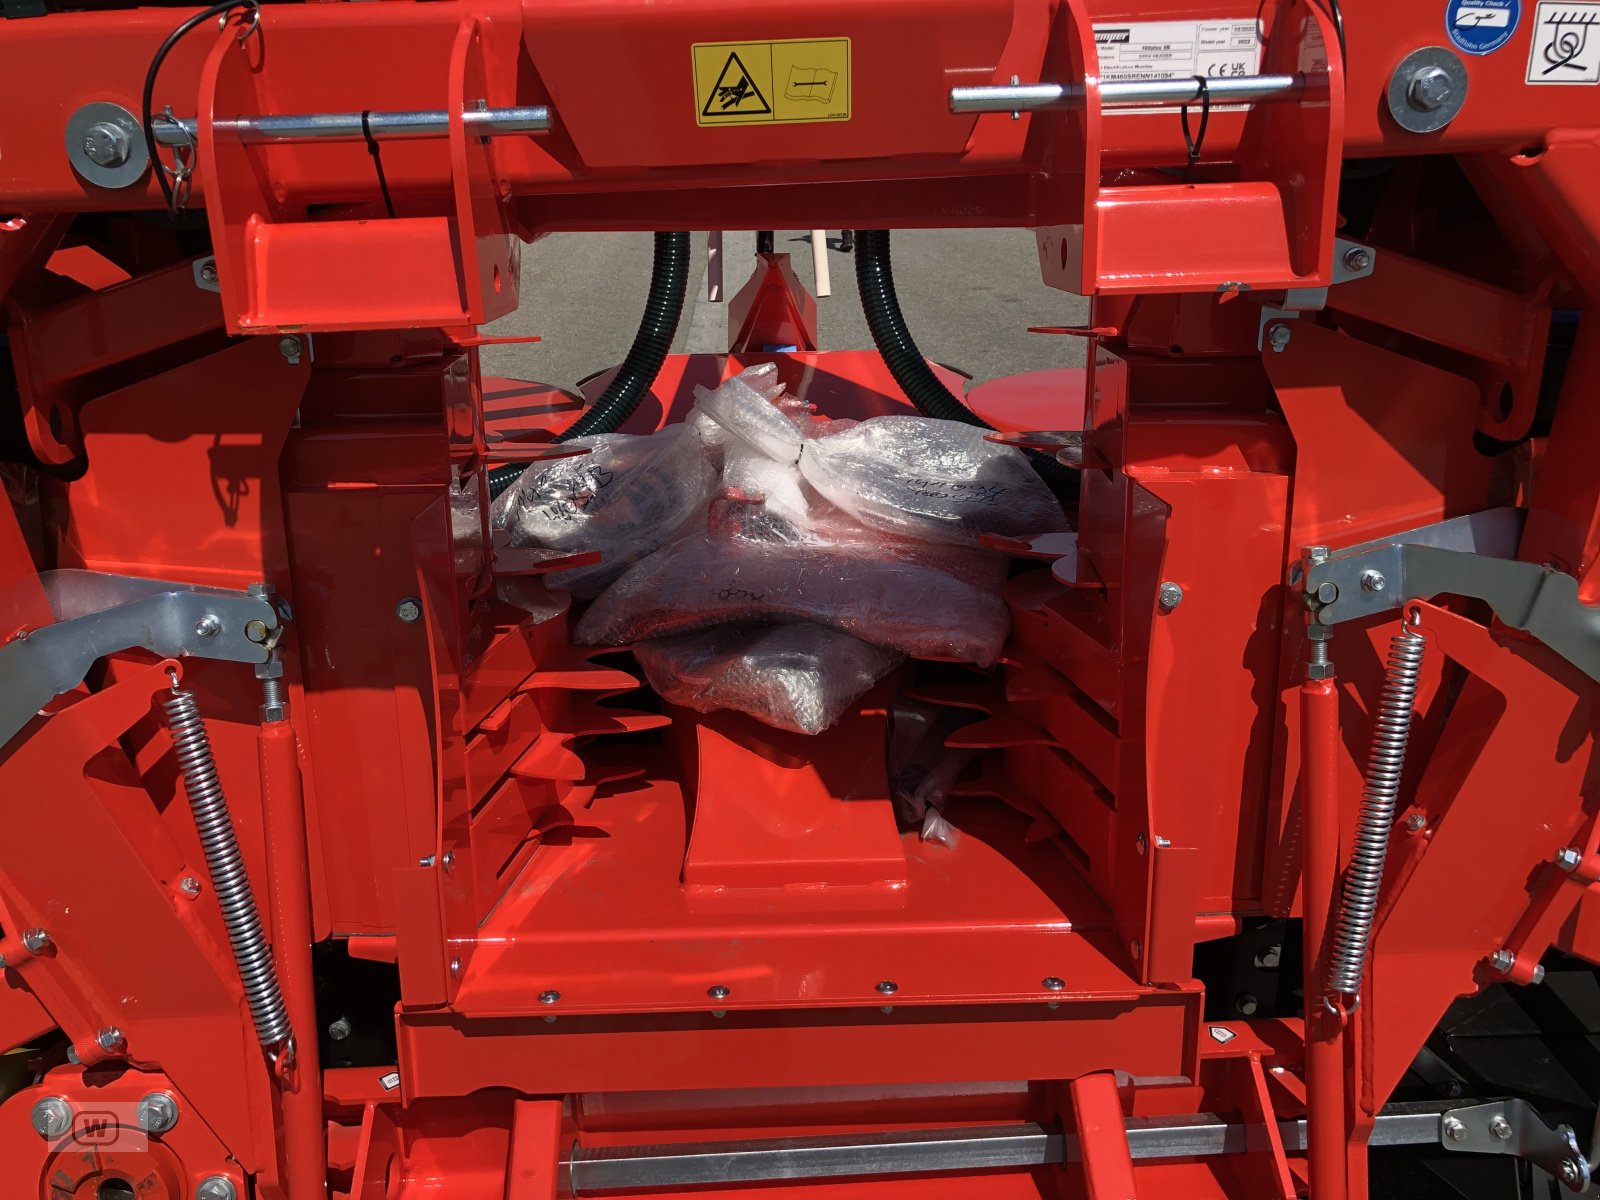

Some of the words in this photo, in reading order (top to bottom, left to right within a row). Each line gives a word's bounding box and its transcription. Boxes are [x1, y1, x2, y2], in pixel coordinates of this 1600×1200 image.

[1095, 31, 1129, 43] emper
[1478, 31, 1508, 49] Germany
[1231, 62, 1246, 71] UK
